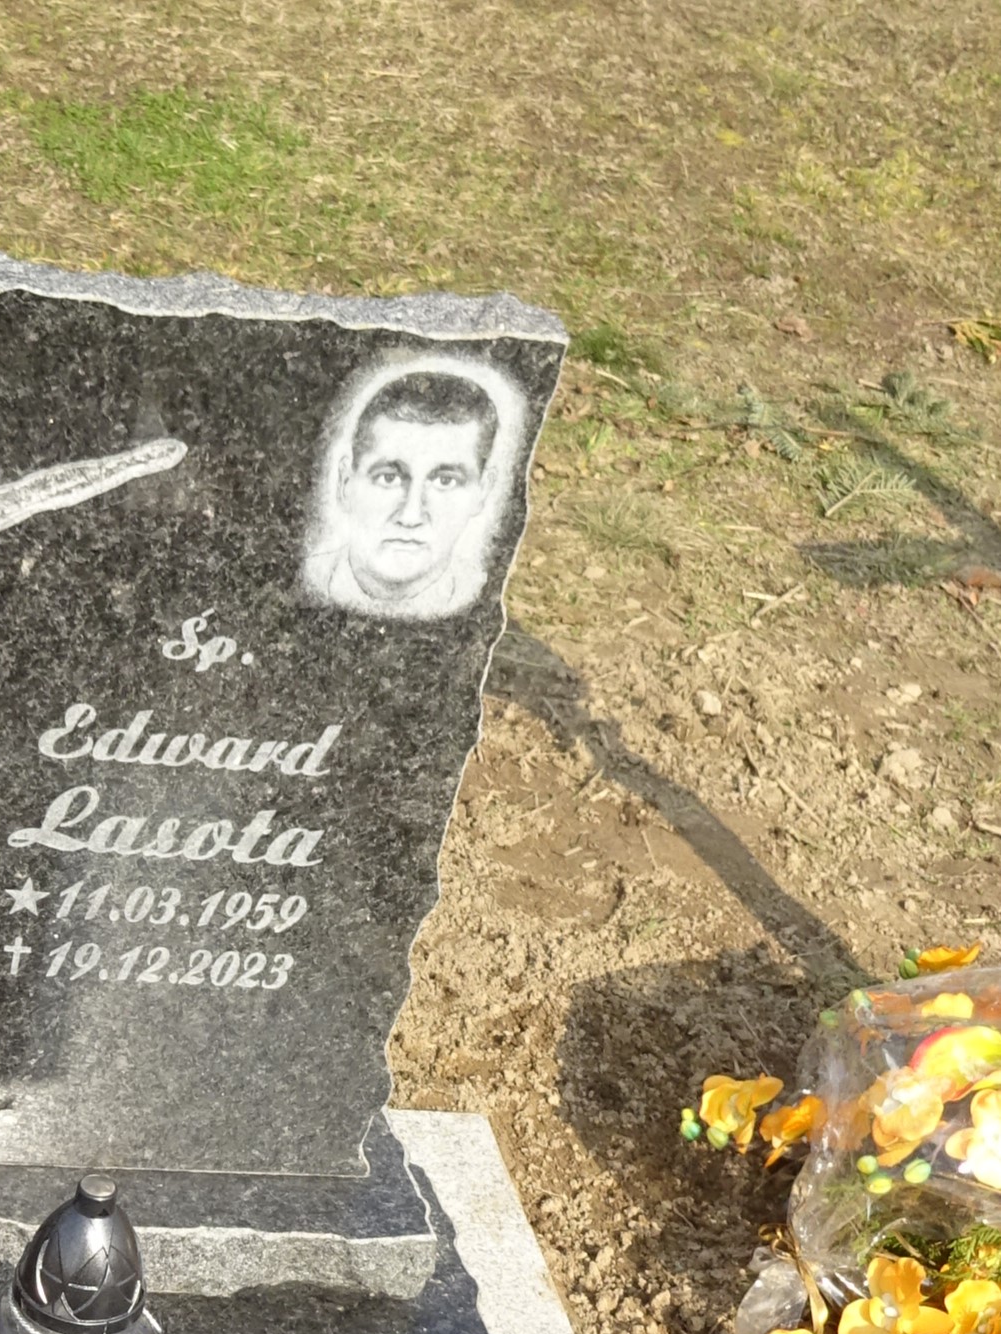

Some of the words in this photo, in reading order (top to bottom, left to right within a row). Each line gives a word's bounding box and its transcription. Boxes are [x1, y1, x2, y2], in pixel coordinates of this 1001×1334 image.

[162, 607, 255, 672] Śp.
[37, 703, 343, 776] Edward
[7, 785, 325, 867] Lasota
[56, 880, 308, 934] 11.03.1959
[45, 940, 295, 990] 19.12.2023
